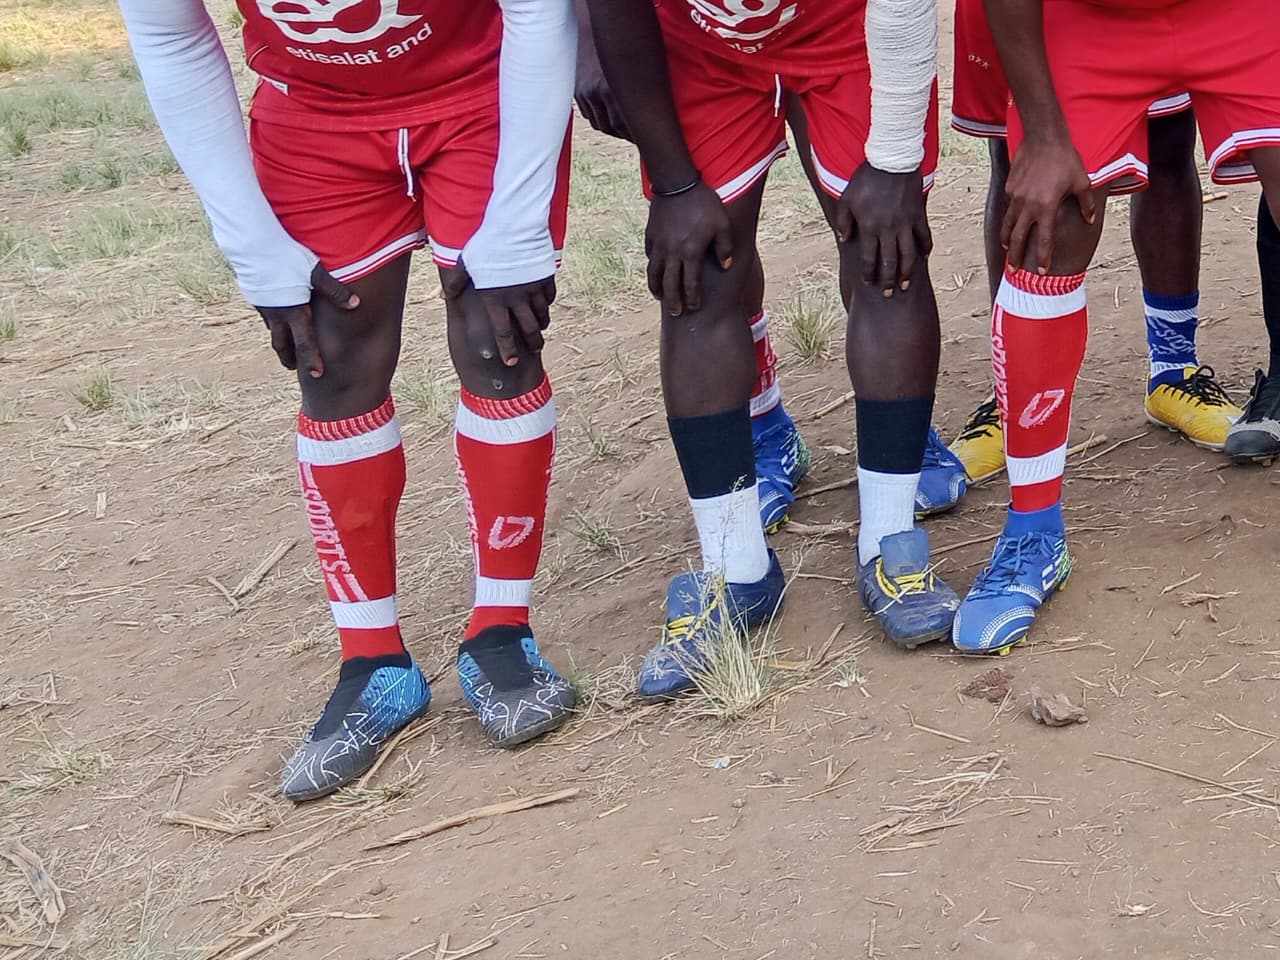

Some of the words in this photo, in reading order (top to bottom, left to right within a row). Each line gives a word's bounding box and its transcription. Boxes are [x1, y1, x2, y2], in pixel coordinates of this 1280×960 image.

[285, 45, 382, 65] etisalat
[387, 22, 433, 58] and
[303, 488, 351, 574] SPORTS
